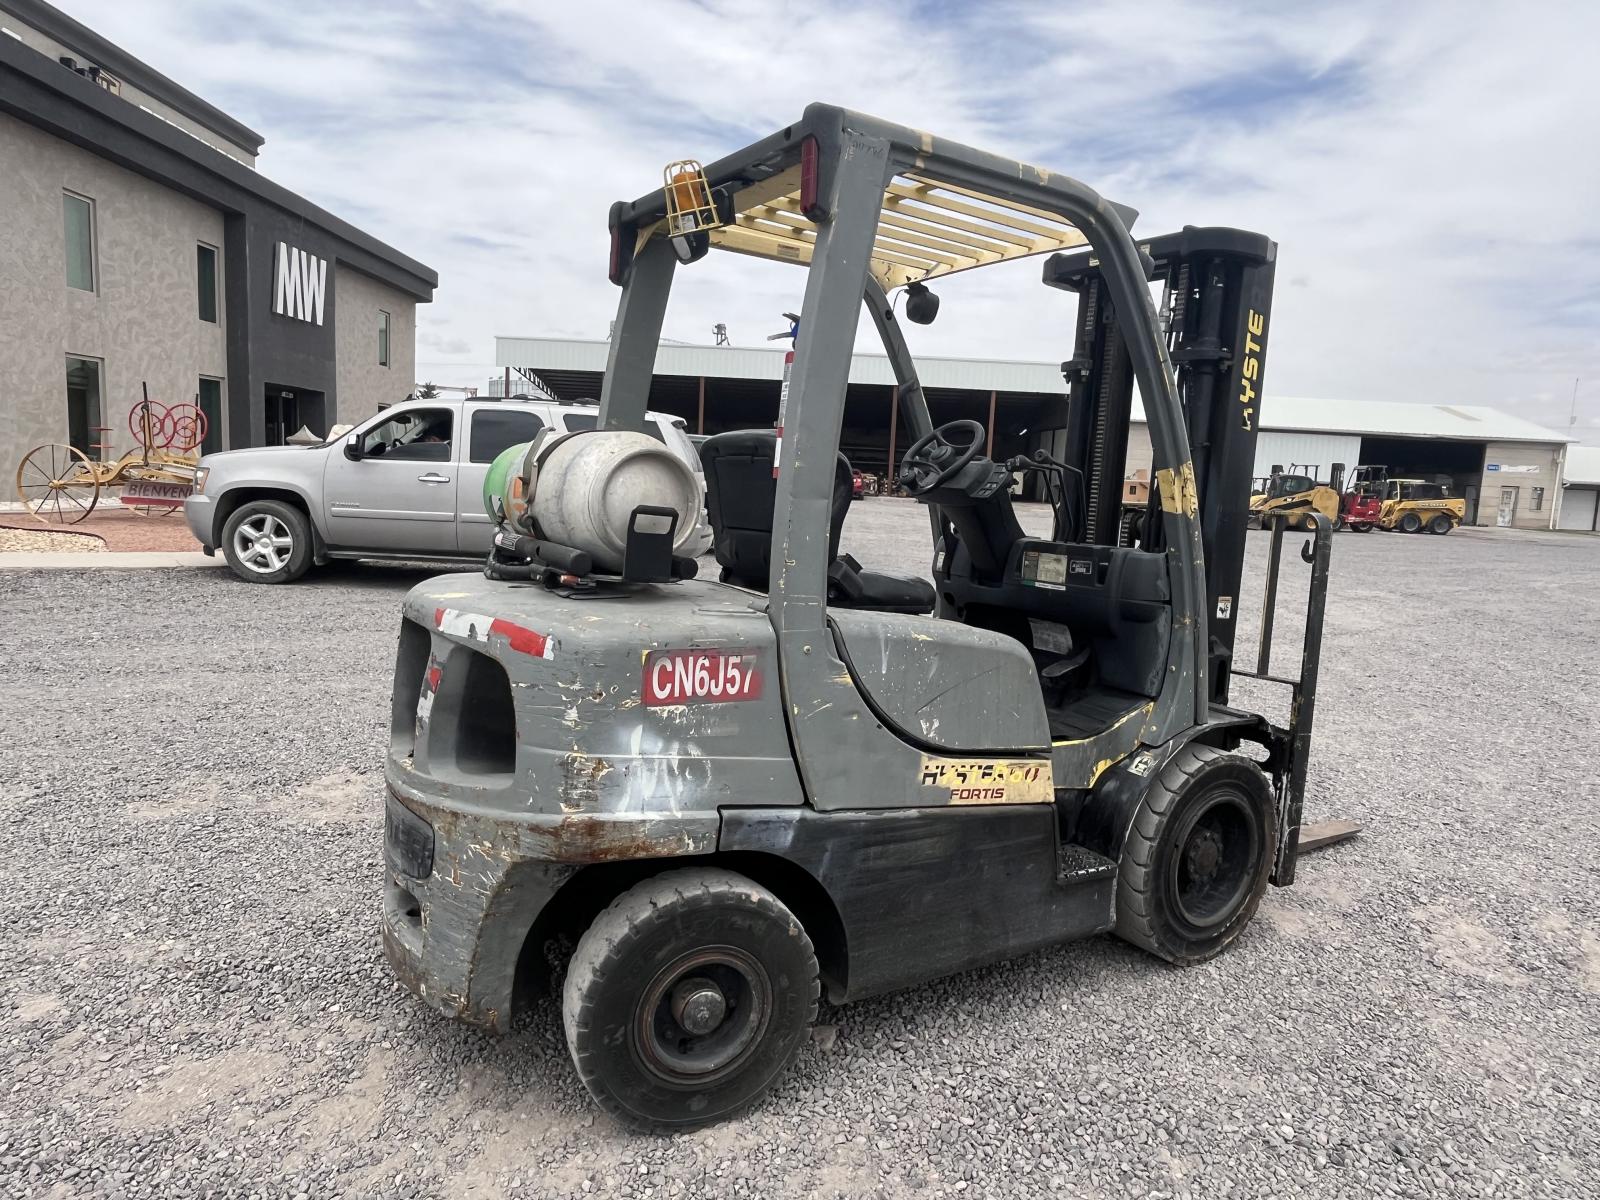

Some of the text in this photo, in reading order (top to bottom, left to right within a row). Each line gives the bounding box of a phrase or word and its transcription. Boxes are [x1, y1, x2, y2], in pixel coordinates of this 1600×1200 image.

[275, 241, 327, 326] MW
[652, 655, 757, 700] CN6J57
[950, 788, 1005, 800] FORTIS
